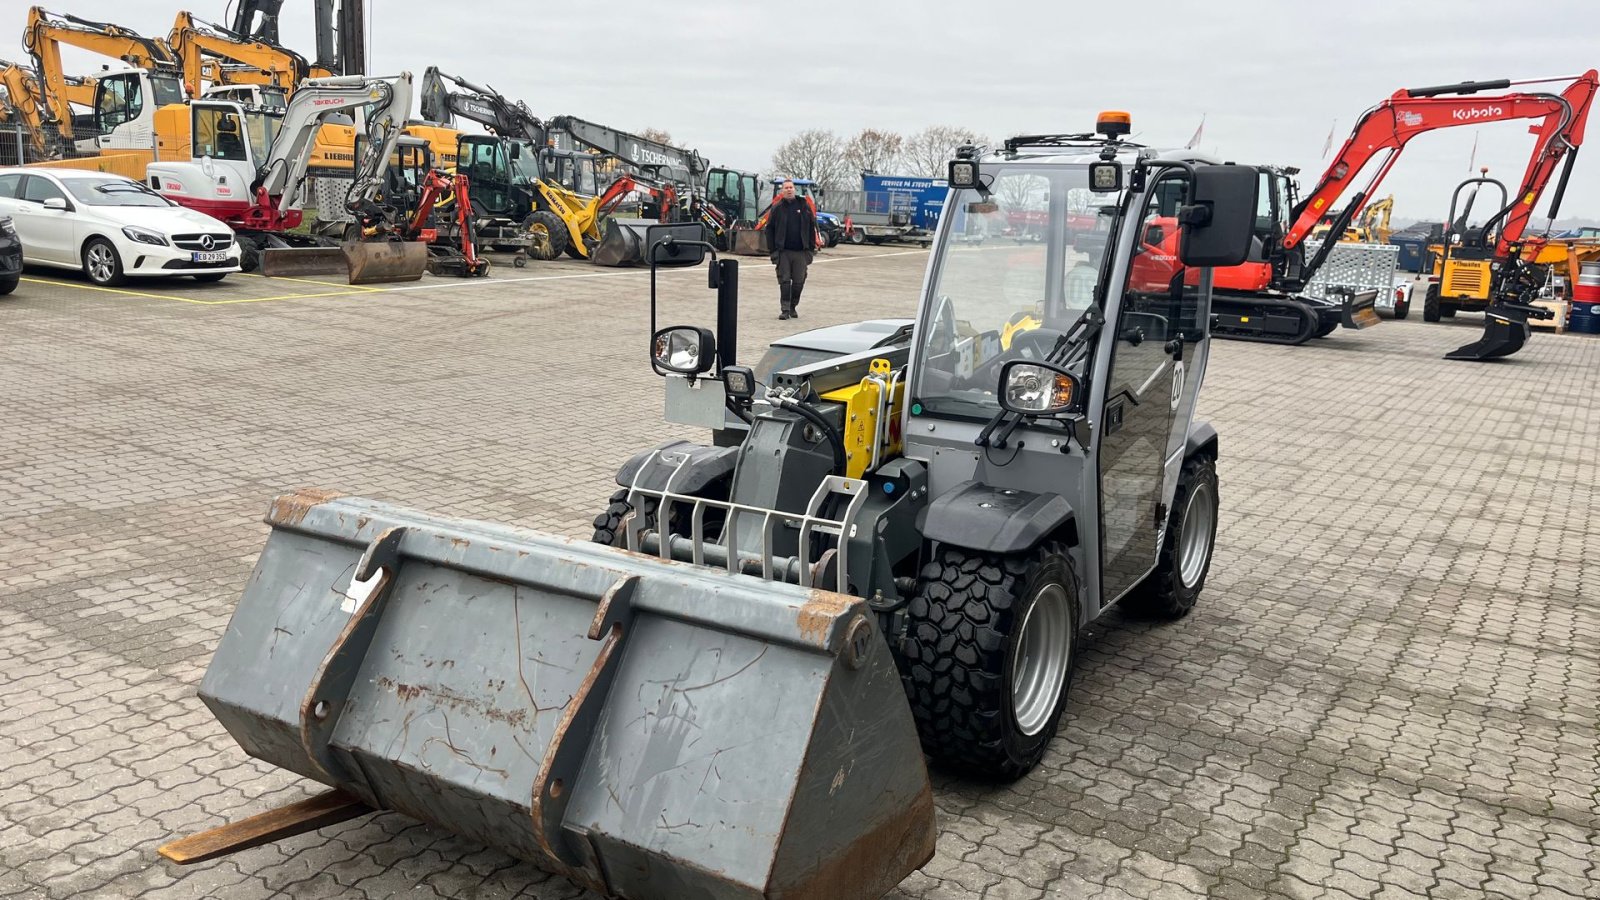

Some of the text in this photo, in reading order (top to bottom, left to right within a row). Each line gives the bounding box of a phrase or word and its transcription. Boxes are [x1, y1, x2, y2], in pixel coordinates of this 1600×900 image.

[1452, 106, 1502, 120] Kubota
[545, 190, 566, 215] KOMATSU
[198, 253, 207, 261] EB
[1172, 367, 1182, 402] 20
